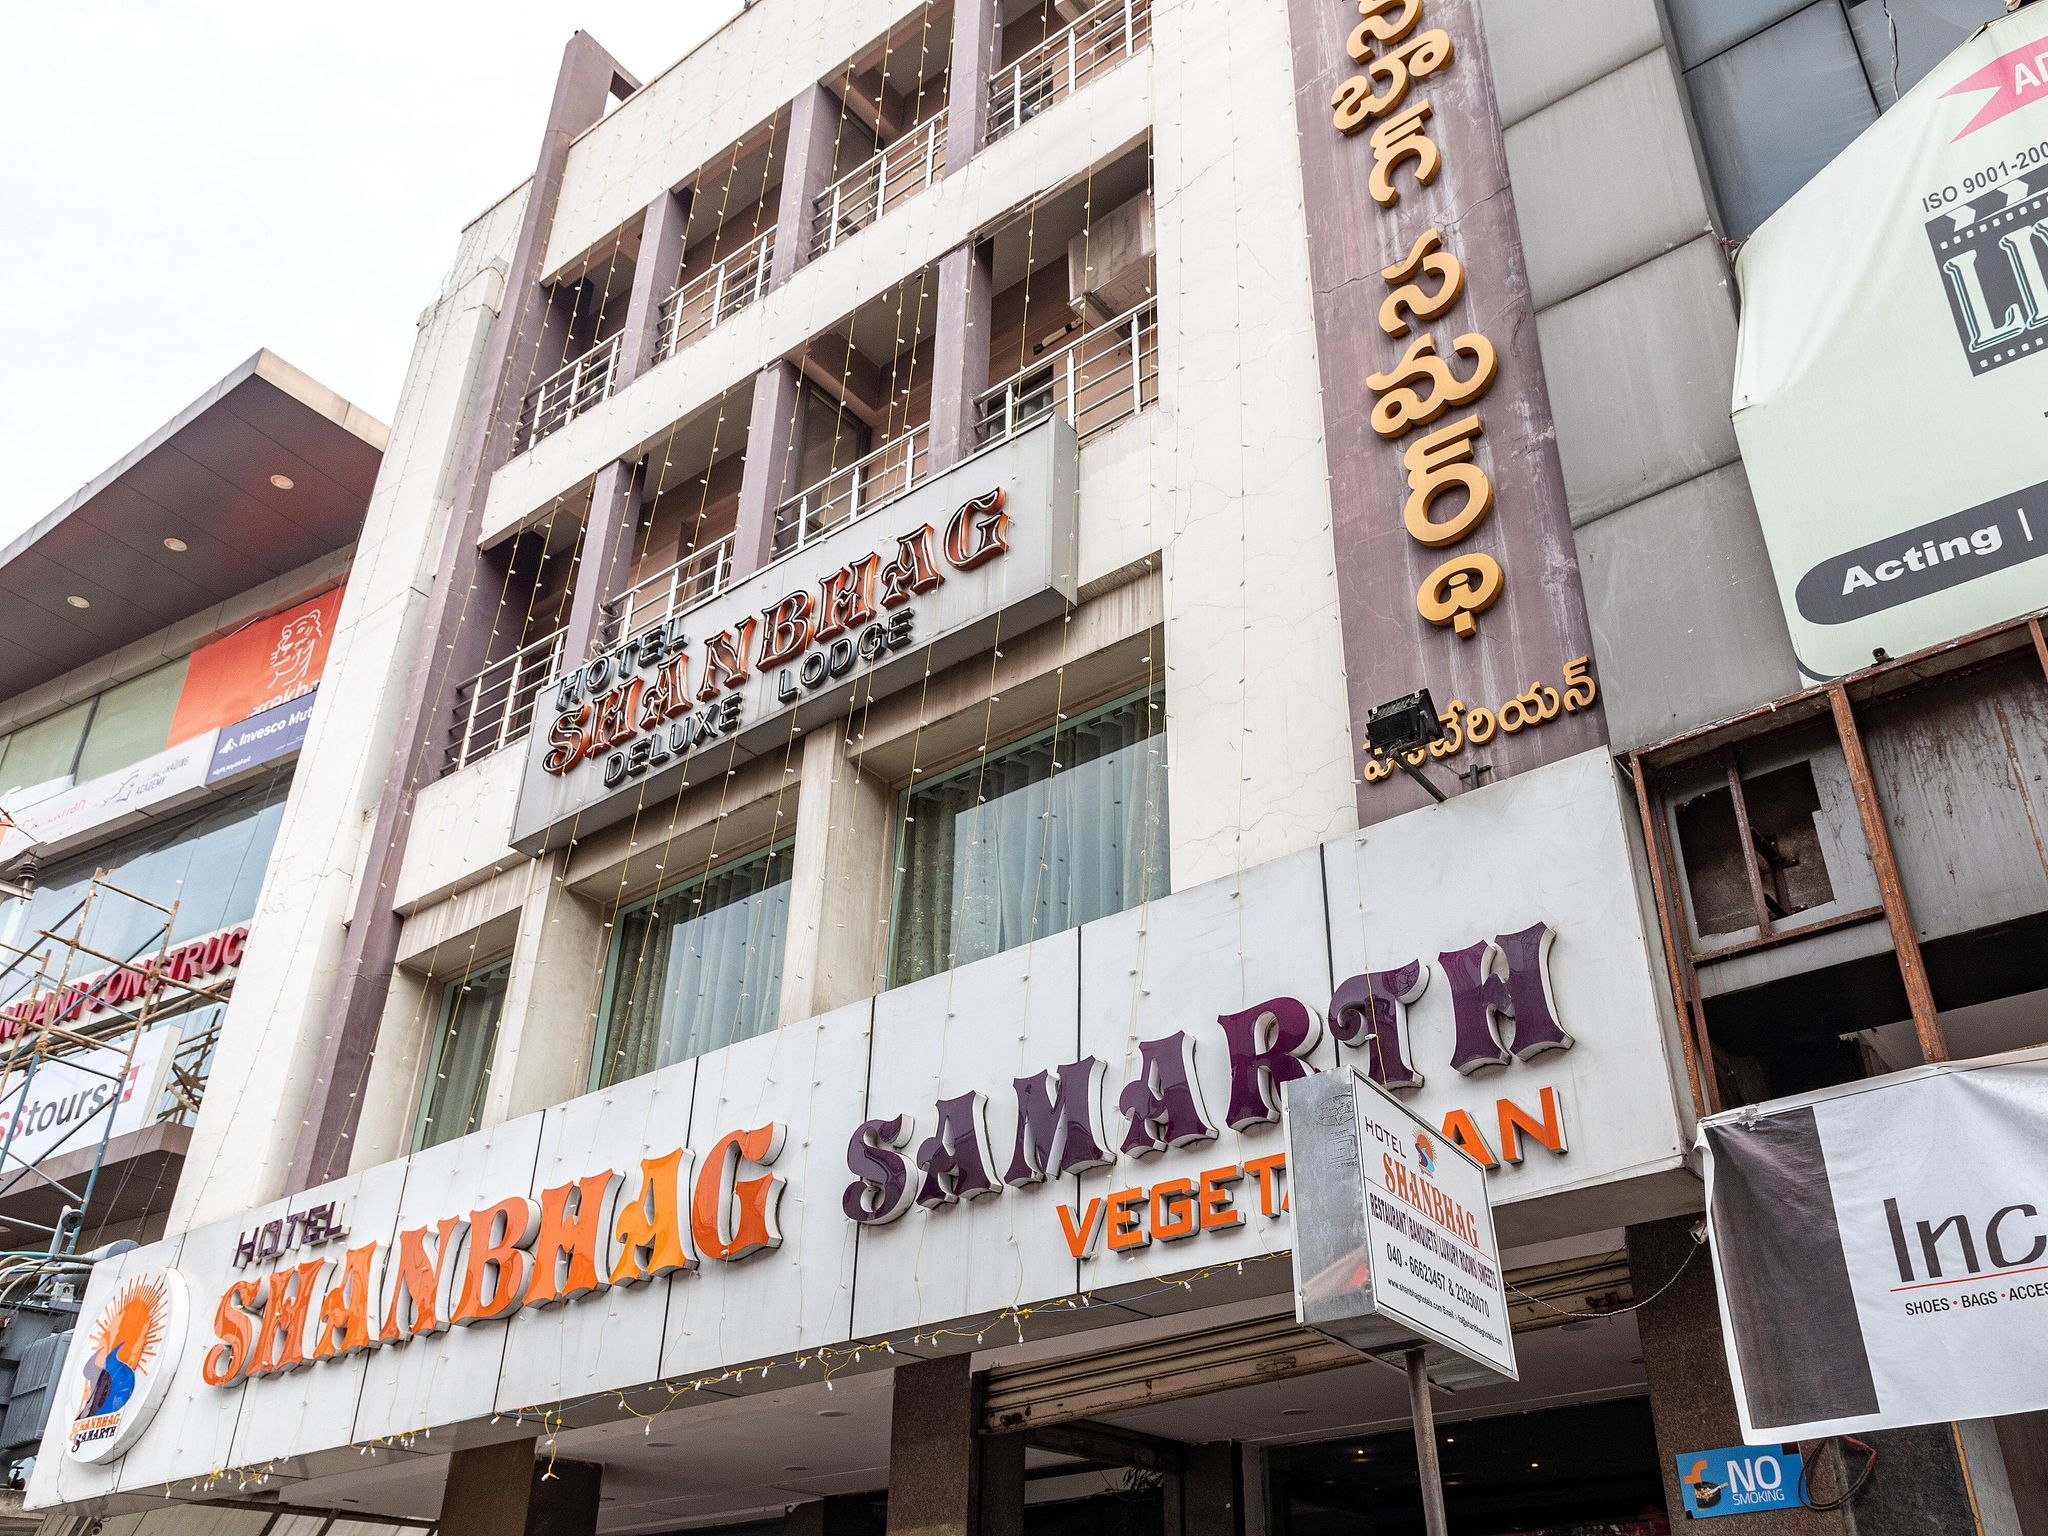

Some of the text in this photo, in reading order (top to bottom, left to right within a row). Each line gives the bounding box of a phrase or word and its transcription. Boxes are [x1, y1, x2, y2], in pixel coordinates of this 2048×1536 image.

[1922, 184, 1959, 213] ISO
[1841, 524, 2004, 597] Acting
[541, 486, 1010, 776] SHANBHAG
[554, 617, 688, 713] HOTEL
[602, 607, 915, 788] DELUXE LODGE
[239, 719, 287, 747] Invesco
[843, 921, 1575, 1225] SAMARTH
[1364, 1115, 1407, 1159] HOTEL
[232, 1200, 350, 1268] HOTEL
[1369, 1192, 1408, 1236] RESTAURANT
[1382, 1152, 1480, 1249] SHANBHAG
[203, 1121, 787, 1388] SHANBHAG
[1386, 1242, 1403, 1268] 040
[1409, 1255, 1446, 1292] 66623457
[1448, 1278, 1455, 1297] &
[1455, 1282, 1490, 1318] 23350070
[1905, 1297, 1950, 1316] SHOES
[1961, 1290, 1998, 1310] BAGS
[71, 1426, 117, 1453] SAMARTH
[1726, 1455, 1782, 1493] NO
[1732, 1488, 1785, 1506] SMOKING
